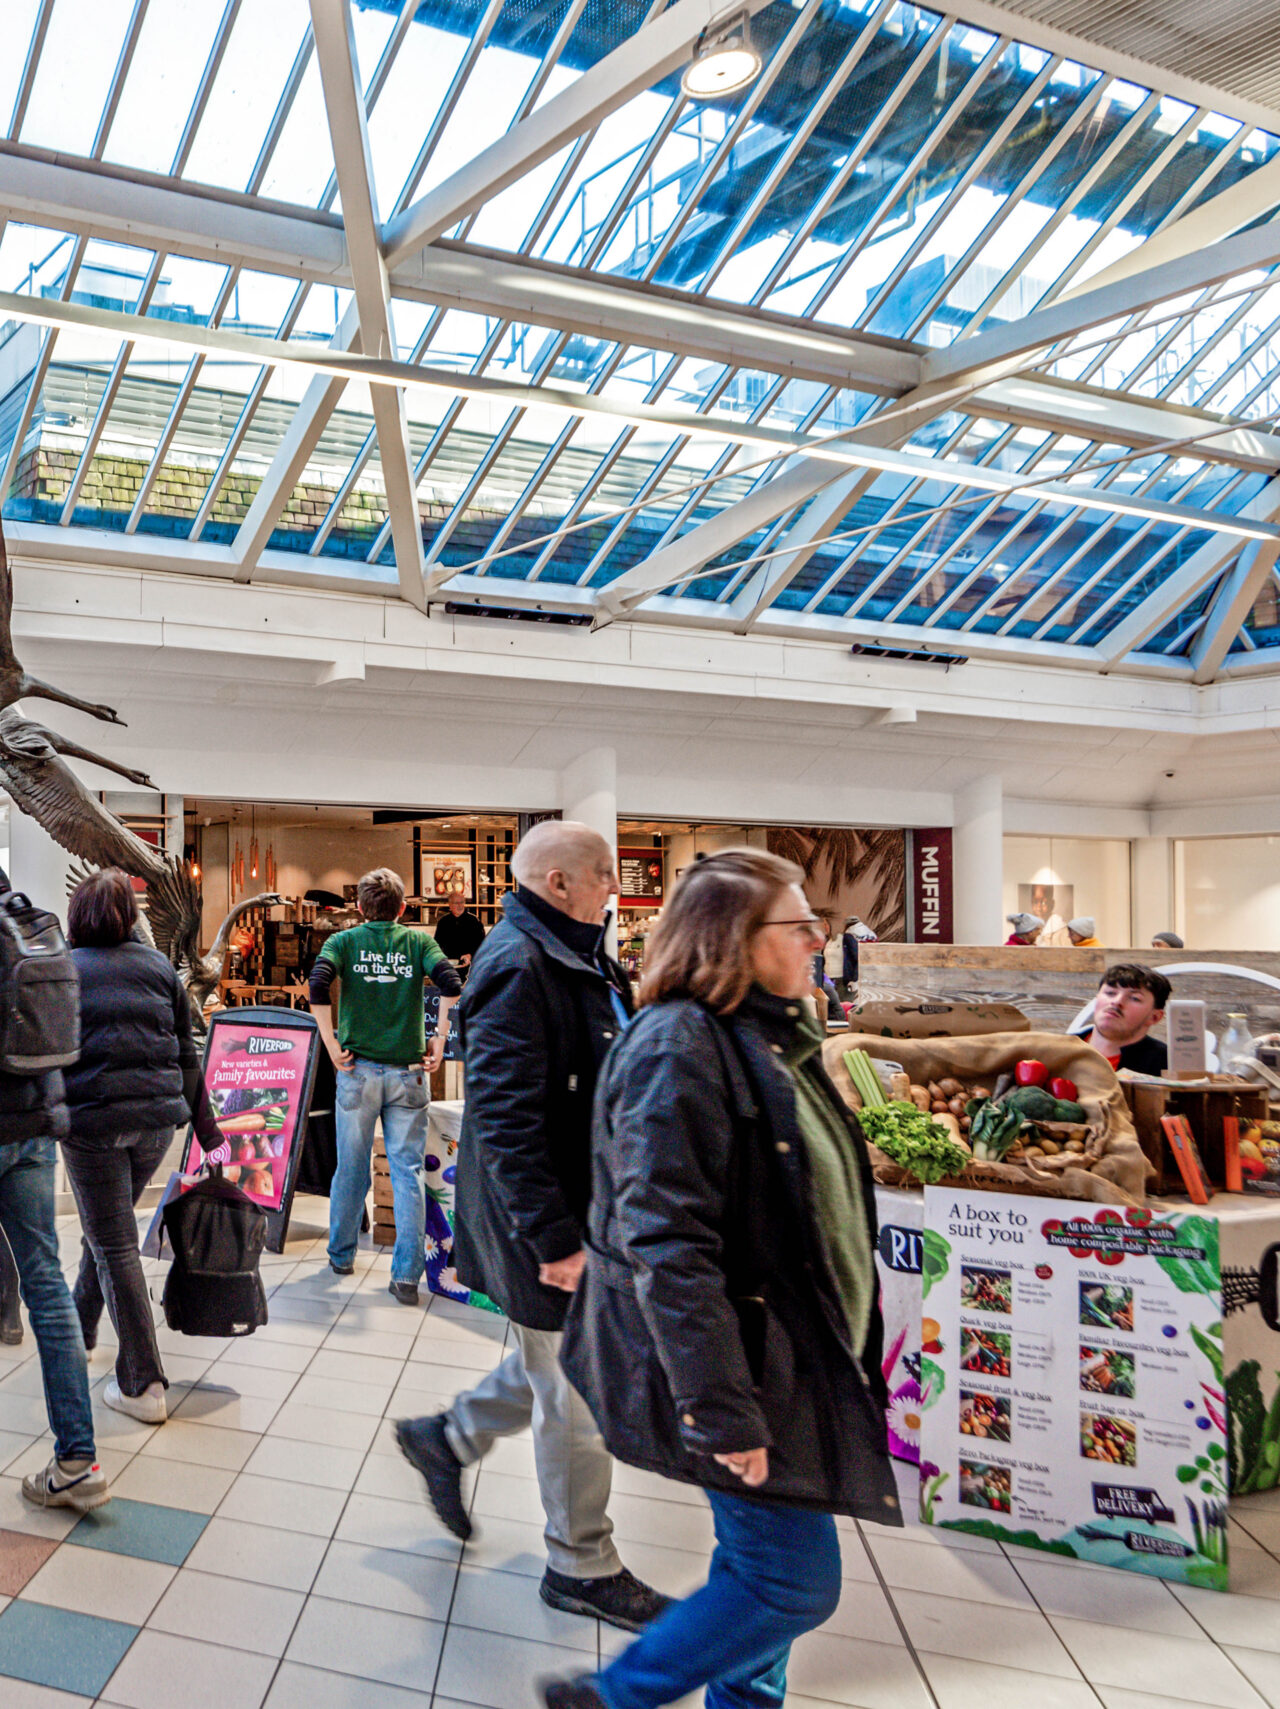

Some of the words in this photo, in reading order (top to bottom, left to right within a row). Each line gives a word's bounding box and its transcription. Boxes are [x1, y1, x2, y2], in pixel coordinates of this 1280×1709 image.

[921, 847, 939, 934] MUFFIN
[360, 950, 383, 962] Live
[386, 952, 406, 965] life
[353, 964, 368, 973] on
[371, 963, 390, 974] the
[392, 965, 413, 978] veg
[248, 1036, 293, 1054] RIVERFORD
[236, 1060, 261, 1068] varieties
[212, 1069, 244, 1085] family
[244, 1067, 296, 1084] favourites
[949, 1203, 961, 1219] A
[966, 1204, 1000, 1224] box
[1008, 1209, 1027, 1226] to
[949, 1223, 982, 1238] suit
[988, 1229, 1024, 1244] you
[1066, 1222, 1079, 1232] All
[1080, 1223, 1104, 1234] 100%
[1148, 1229, 1174, 1239] with
[1050, 1234, 1079, 1246] home
[1080, 1238, 1146, 1252] compostable
[1147, 1243, 1203, 1259] packaging
[994, 1260, 1008, 1269] veg
[1009, 1260, 1024, 1270] box
[1108, 1487, 1137, 1500] FREE
[1097, 1497, 1153, 1514] DELIVERY
